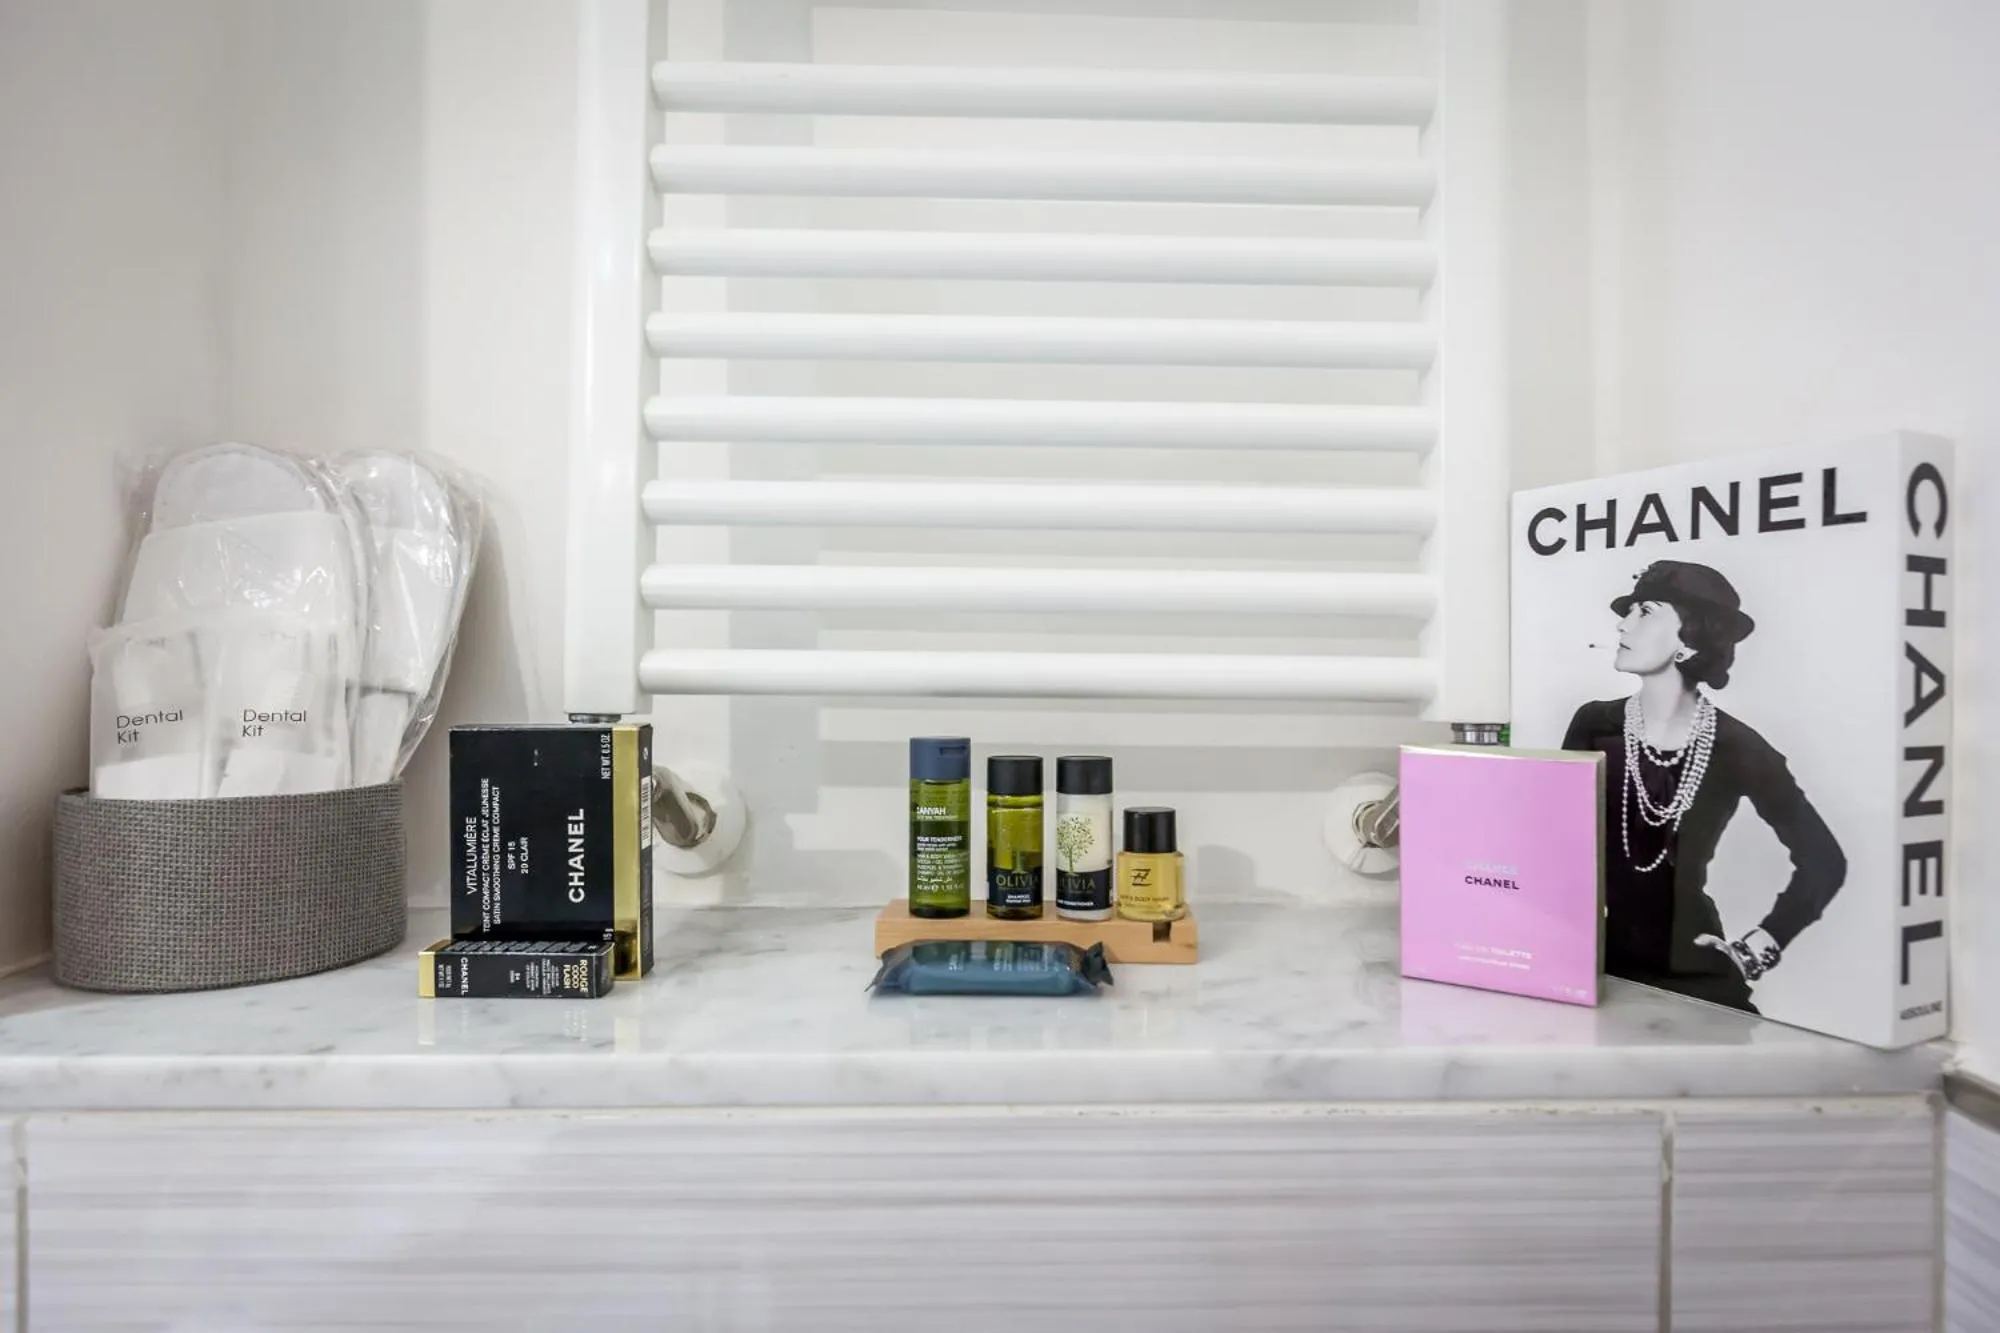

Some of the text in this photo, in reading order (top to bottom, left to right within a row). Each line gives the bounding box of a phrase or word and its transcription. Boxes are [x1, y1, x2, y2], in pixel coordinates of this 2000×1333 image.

[1527, 467, 1868, 556] CHANEL
[117, 709, 183, 728] Dental
[242, 724, 265, 738] Kit
[243, 708, 308, 723] Dental
[1901, 462, 1948, 986] CHANEL
[117, 729, 140, 745] Kit
[481, 779, 489, 817] JEUNESSE
[491, 786, 500, 824] COMPACT
[464, 816, 477, 895] VITALUMIÈRE
[508, 841, 516, 870] SPF 15
[520, 837, 529, 874] 20 CLAIR
[568, 808, 585, 903] CHANEL
[482, 872, 490, 910] COMPACT
[492, 854, 501, 901] SMOOTHING
[1464, 875, 1520, 890] CHANEL
[493, 902, 501, 924] SATIN
[460, 957, 469, 996] CHANEL
[563, 964, 571, 989] FLASH
[571, 964, 580, 989] COCO
[580, 959, 589, 993] ROUGE
